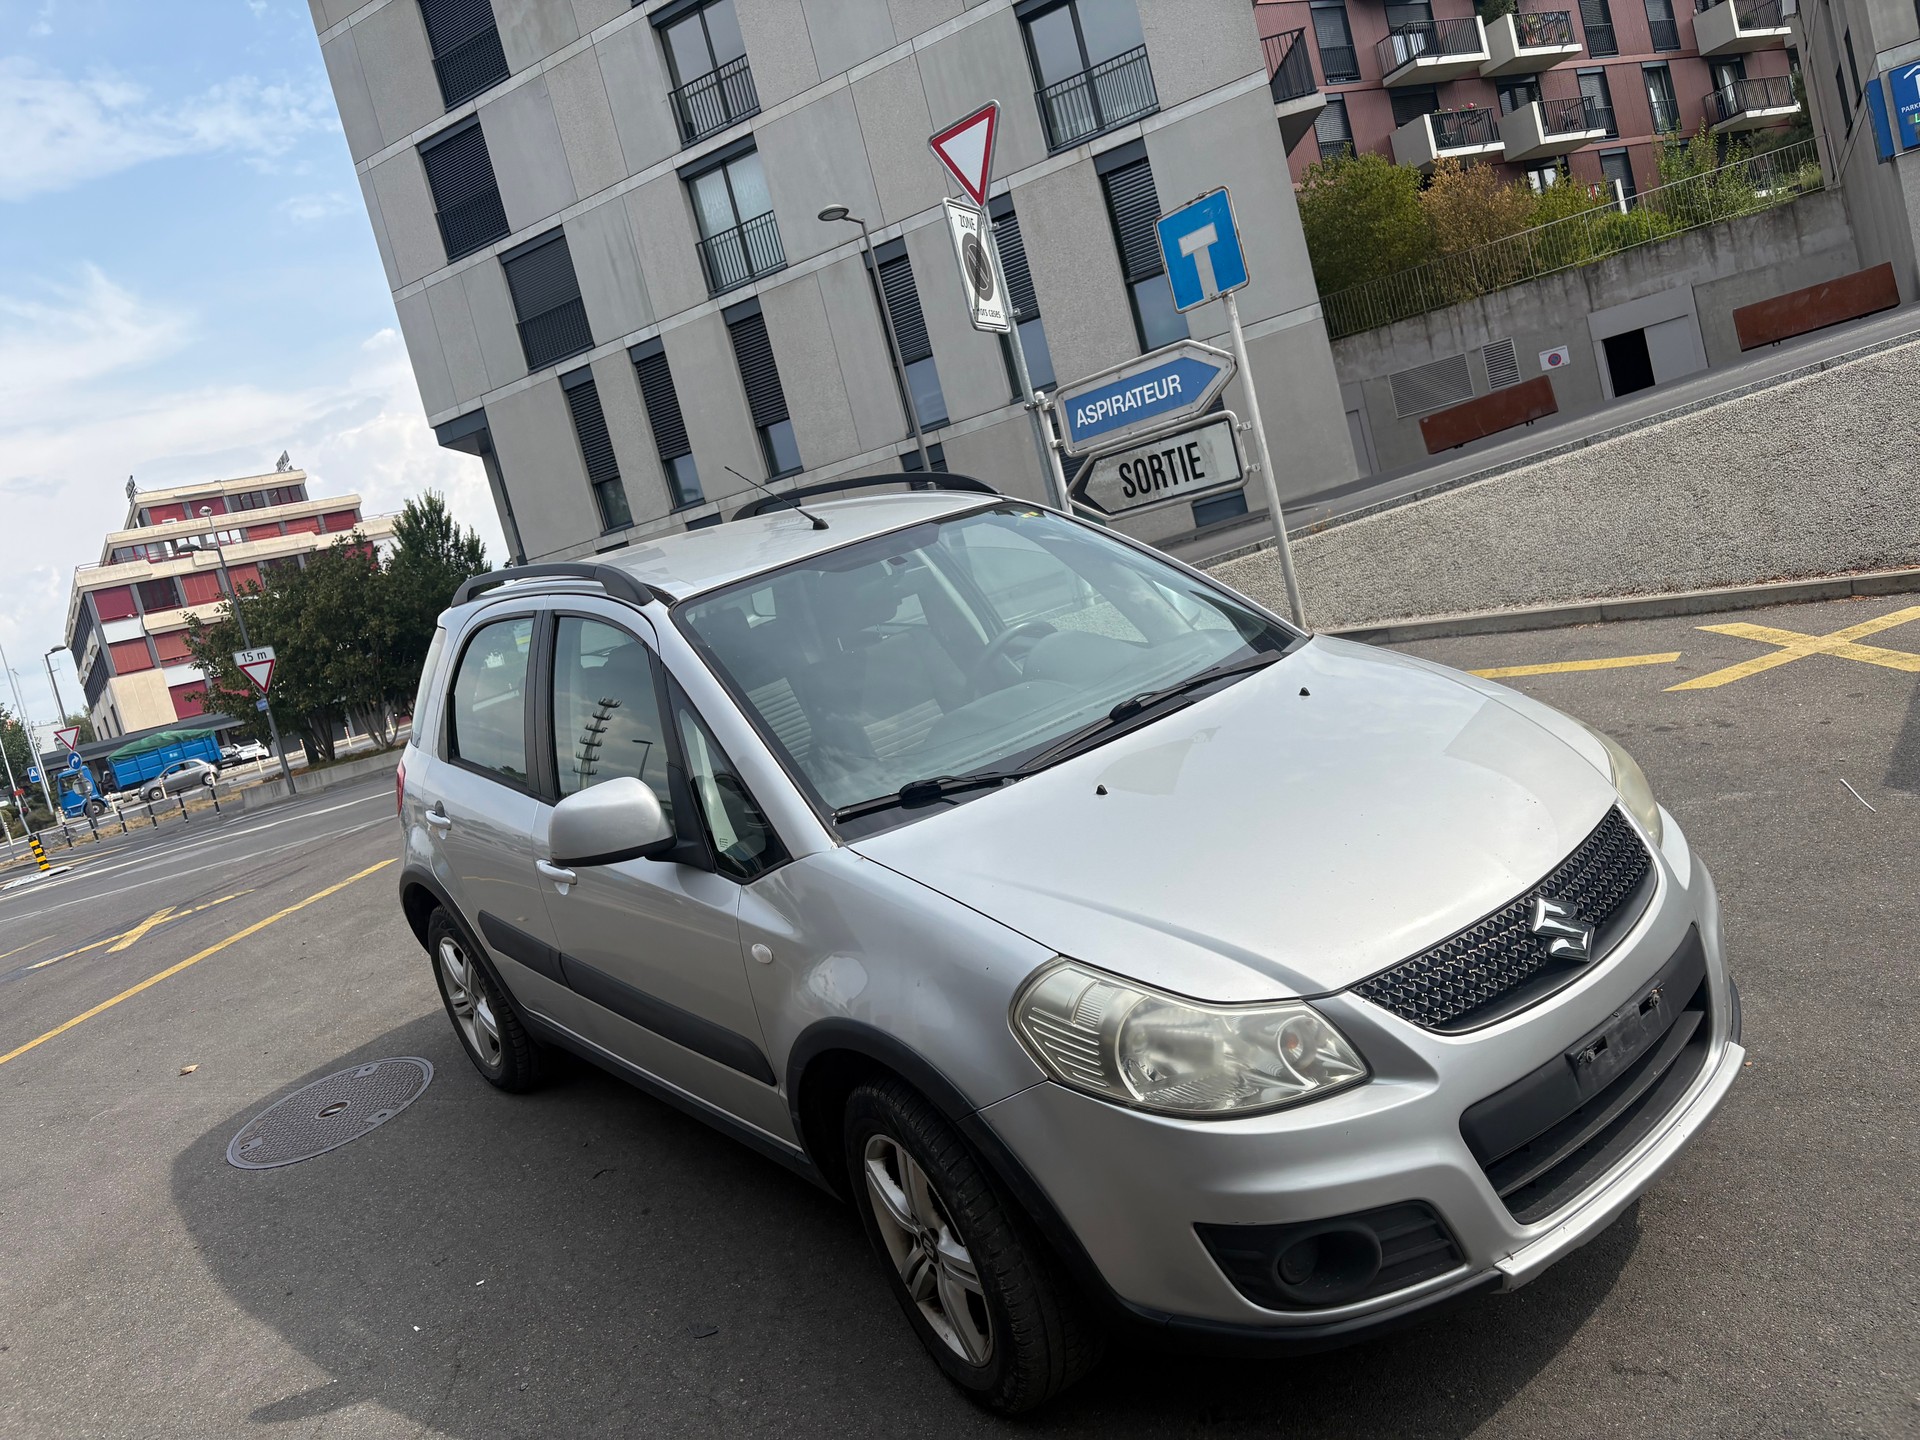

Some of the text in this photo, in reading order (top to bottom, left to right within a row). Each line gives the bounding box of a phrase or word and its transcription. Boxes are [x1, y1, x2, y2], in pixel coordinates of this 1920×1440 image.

[958, 214, 976, 231] ZONE
[989, 309, 1002, 319] cases
[1077, 374, 1183, 428] ASPIRATEUR
[1118, 441, 1206, 499] SORTIE
[242, 651, 267, 662] 15 m
